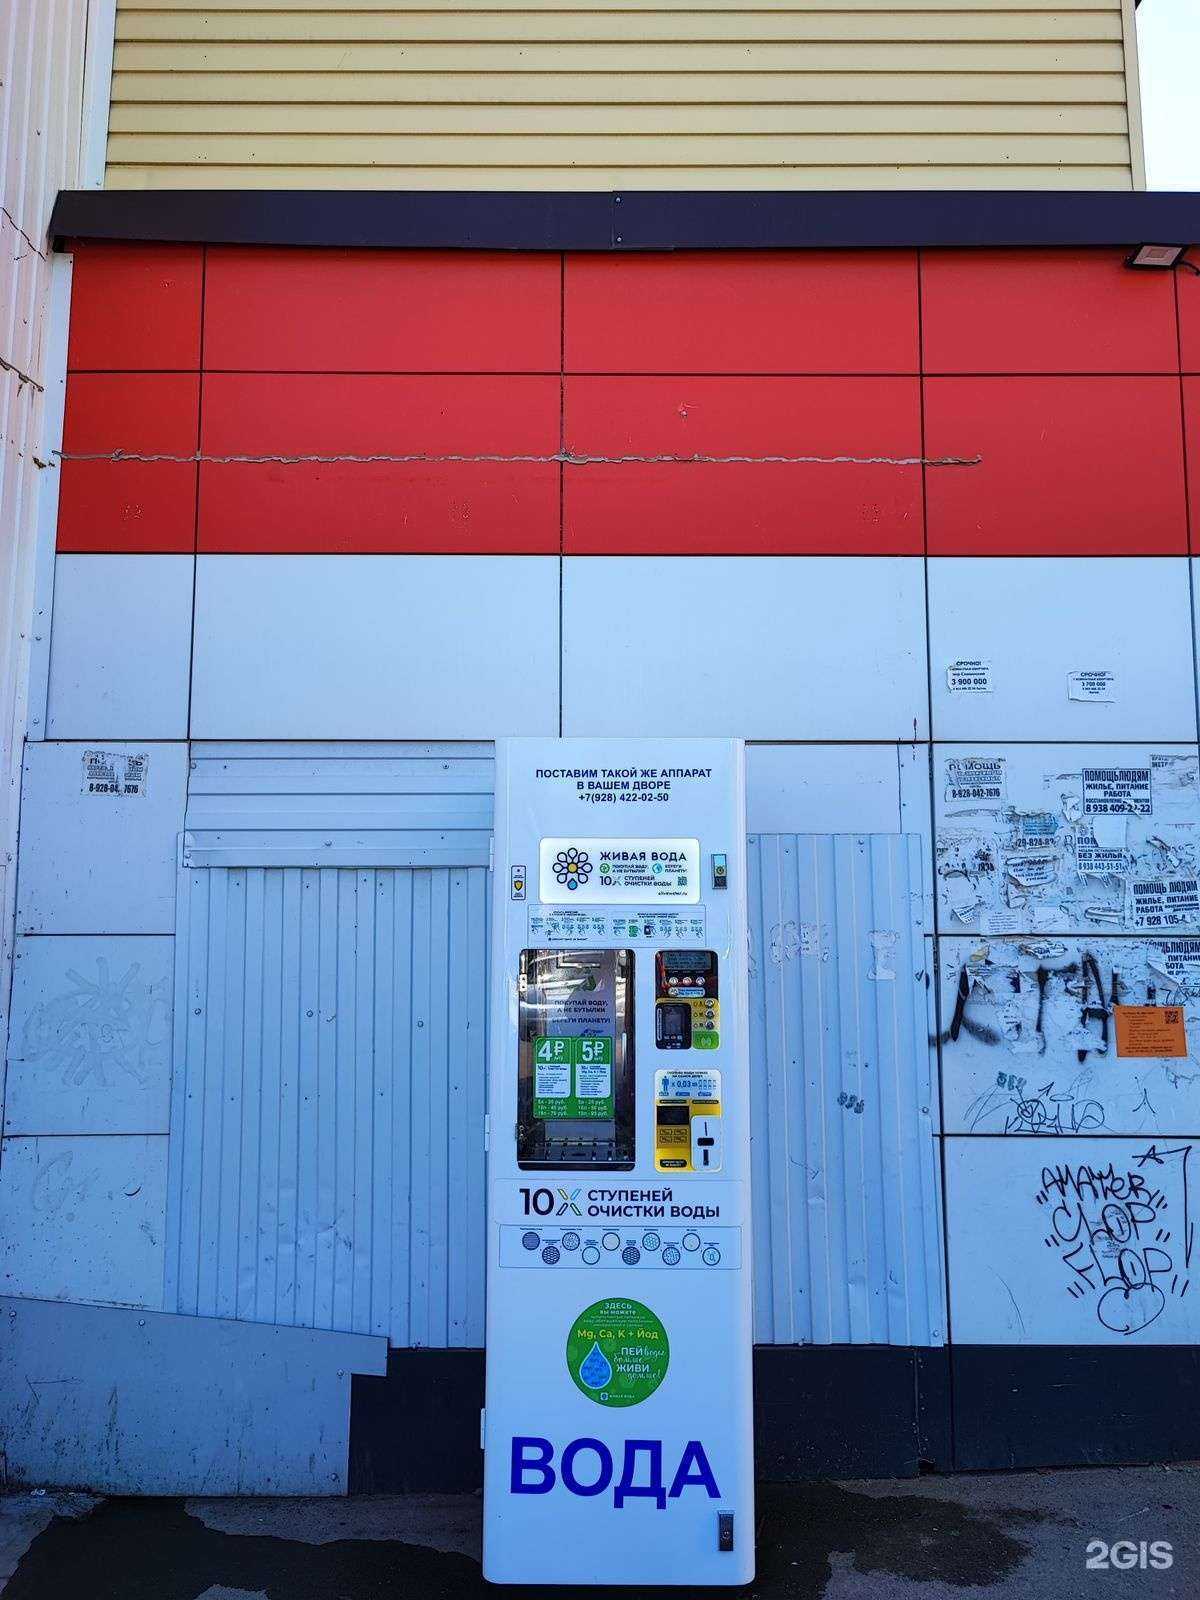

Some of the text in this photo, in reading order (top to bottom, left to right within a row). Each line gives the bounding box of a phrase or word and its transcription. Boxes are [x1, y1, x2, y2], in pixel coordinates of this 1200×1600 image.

[536, 767, 712, 778] ПОСТАВИМ ТАКОЙ ЖЕ АППАРАТ
[1084, 770, 1149, 783] ПОМОЩЬ ЛЮДЯМ
[576, 781, 671, 791] В ВАШЕМ ДВОРЕ
[578, 793, 669, 803] +7(928) 422-02-50
[1086, 804, 1092, 813] 8
[1093, 804, 1109, 813] 938
[600, 852, 687, 862] ЖИВАЯ ВОДА
[1133, 881, 1199, 895] ПОМОЩЬ ЛЮДЯМ
[1166, 895, 1199, 903] ПИТАНИЕ
[1136, 905, 1164, 913] РАБОТА
[1135, 917, 1144, 927] +7
[1146, 915, 1162, 926] 928
[588, 1187, 673, 1202] СТУПЕНЕЙ
[588, 1205, 720, 1220] ОЧИСТКИ ВОДЫ
[605, 1302, 632, 1310] ЗДЕСЬ
[577, 1329, 597, 1340] Mg,
[599, 1329, 615, 1339] Ca,
[618, 1329, 626, 1338] K
[637, 1328, 659, 1340] Йод
[621, 1345, 643, 1356] ПЕЙ
[616, 1363, 650, 1373] ЖИВИ
[510, 1436, 722, 1510] ВОДА
